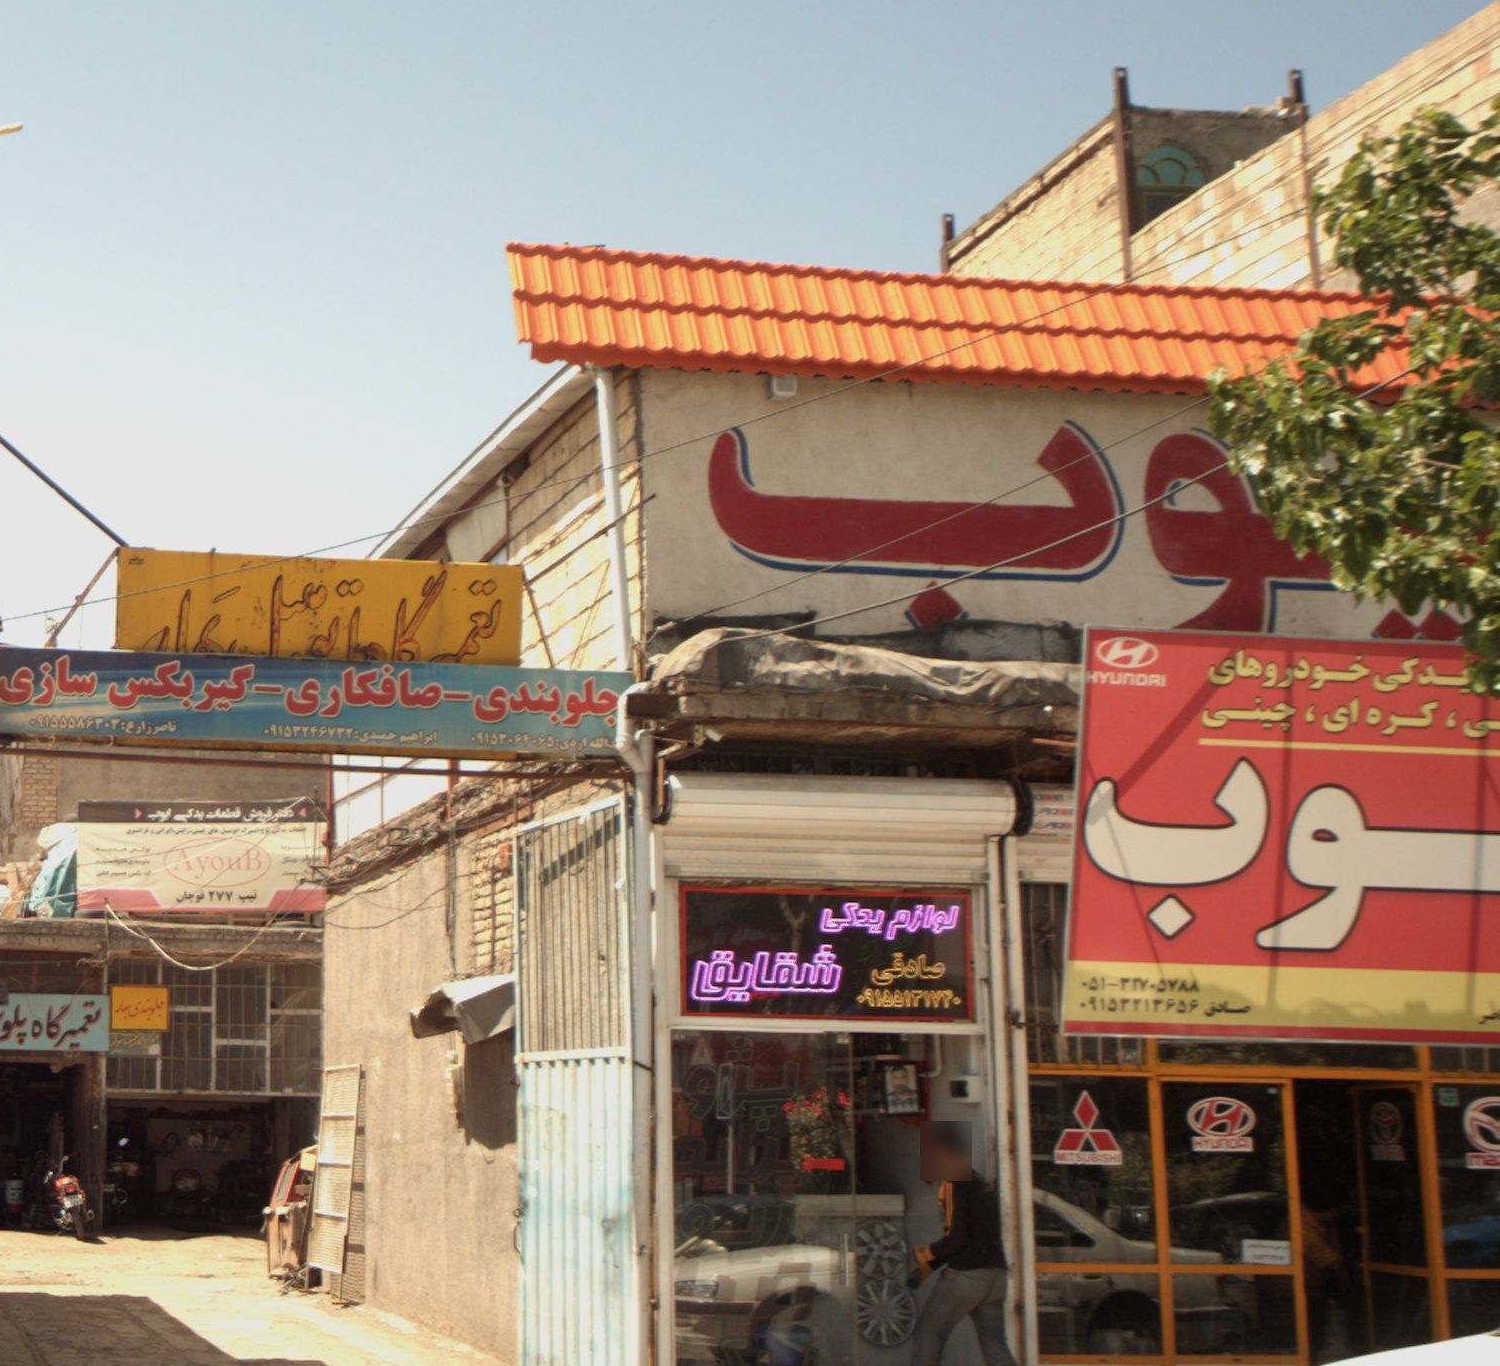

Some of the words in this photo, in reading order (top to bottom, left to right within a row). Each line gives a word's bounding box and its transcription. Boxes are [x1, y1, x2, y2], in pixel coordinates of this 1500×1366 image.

[107, 660, 255, 712] گیربکس
[284, 663, 443, 717] صافکاری
[1200, 697, 1296, 731] چینی
[819, 901, 885, 933] یدکی
[885, 903, 961, 940] لوازم
[691, 943, 843, 1003] شقایق
[1056, 1152, 1122, 1164] MITSUBISHI
